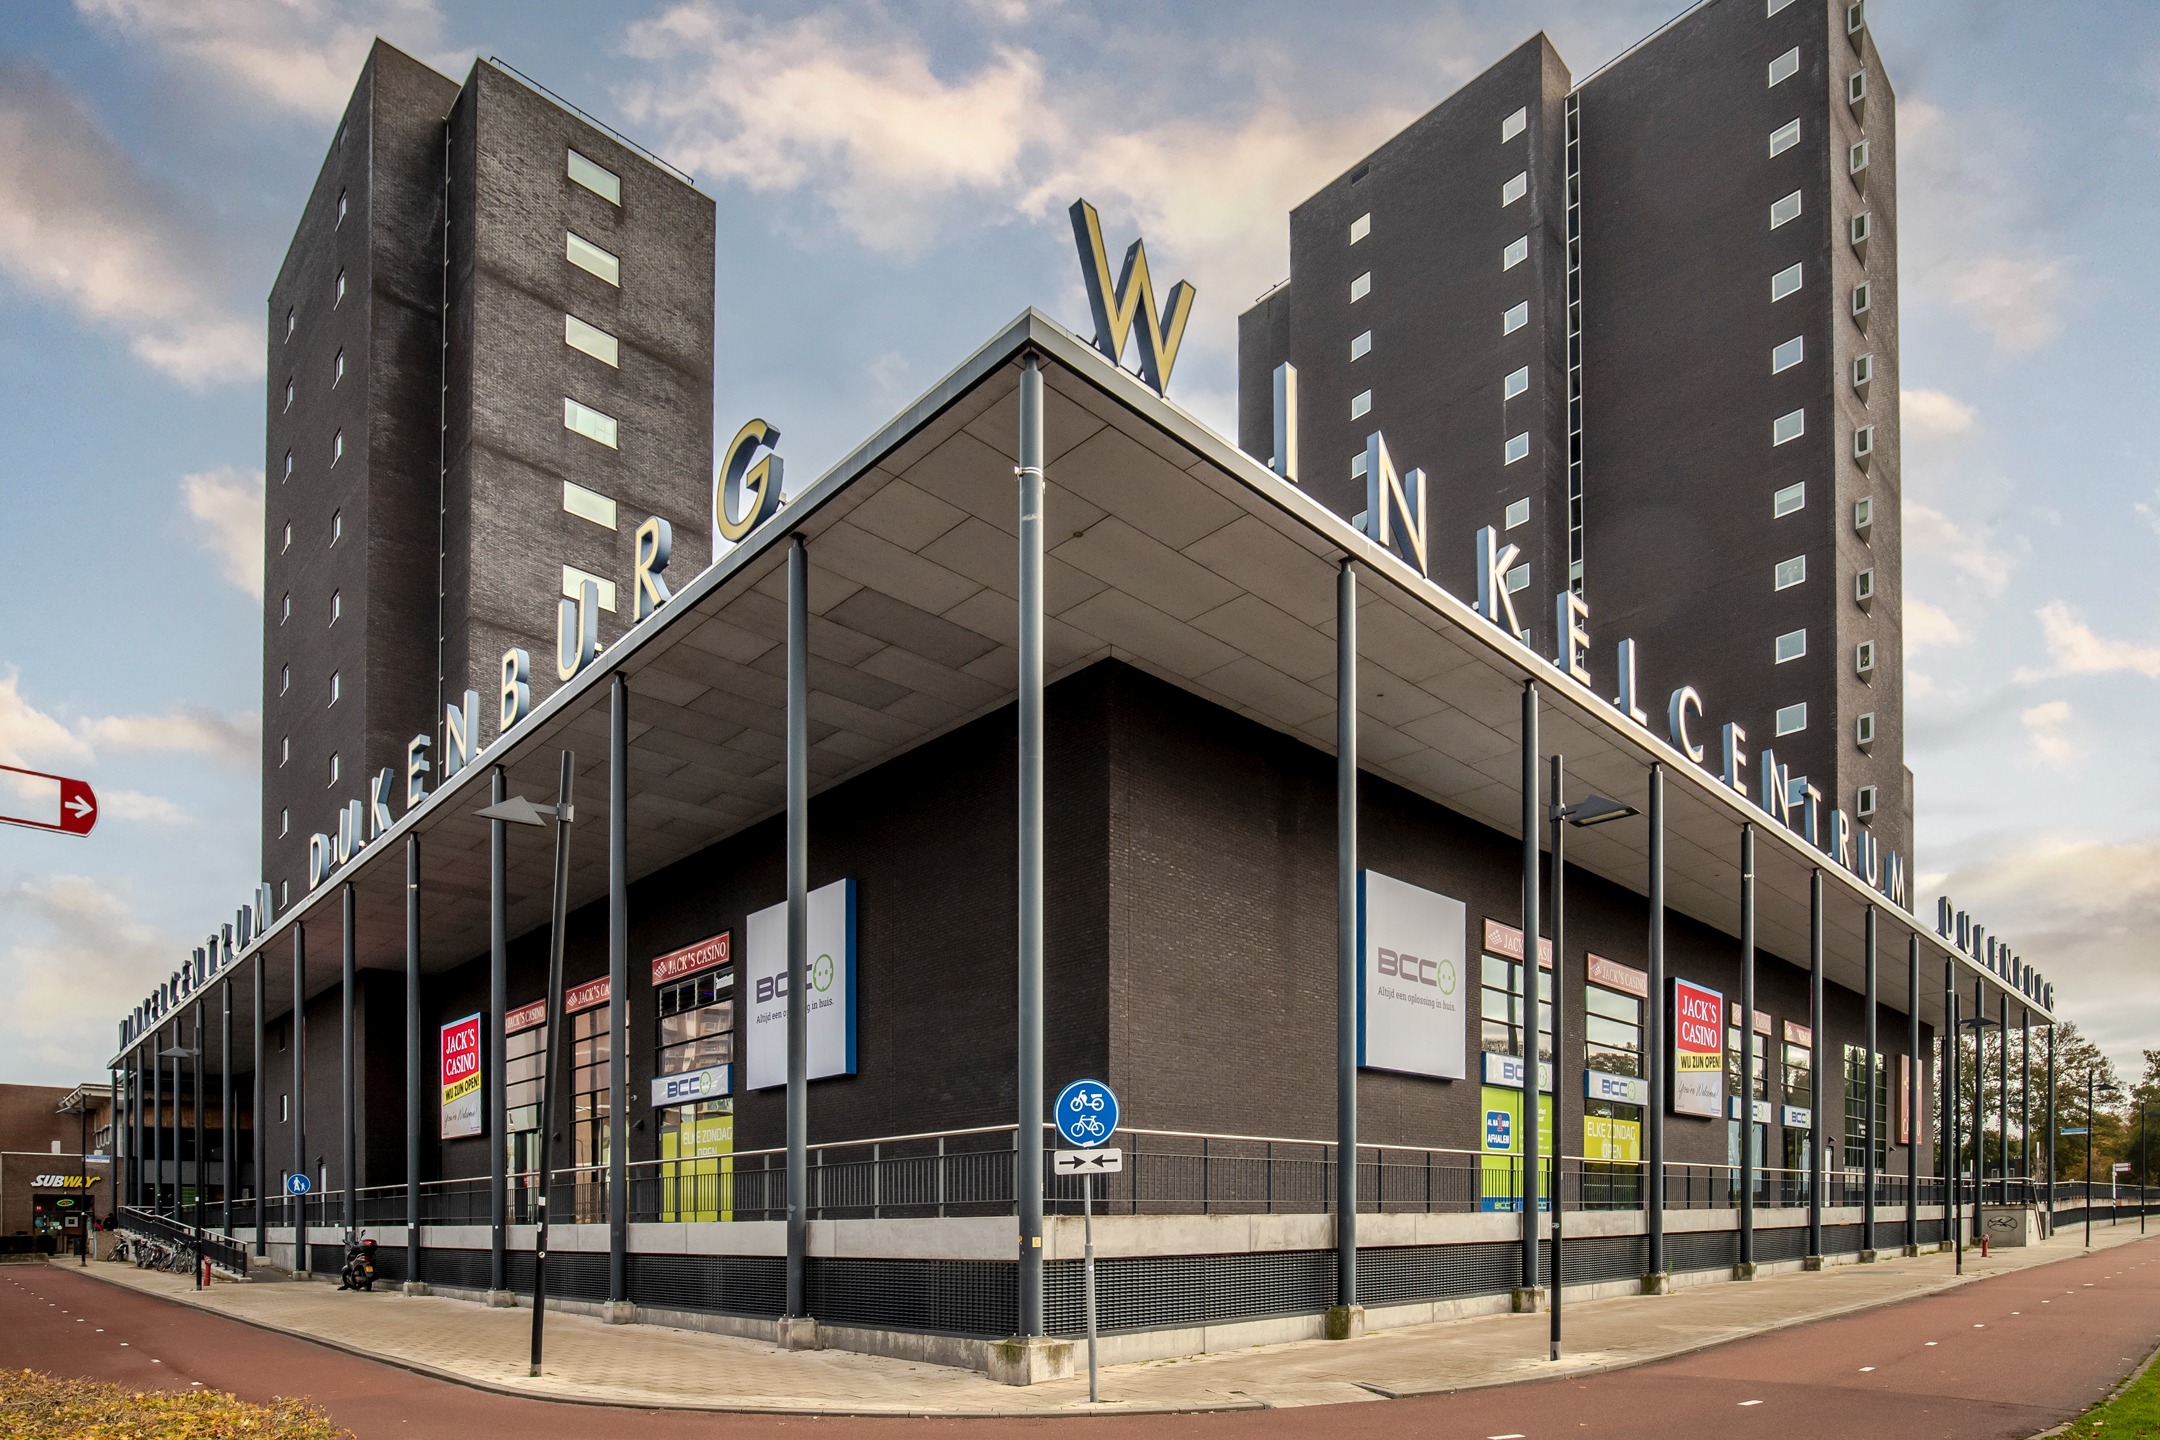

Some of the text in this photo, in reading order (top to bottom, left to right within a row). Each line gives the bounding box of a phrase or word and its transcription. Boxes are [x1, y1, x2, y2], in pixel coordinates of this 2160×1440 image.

[1069, 198, 2056, 1013] WINKELCENTRUM DUKENBURG
[118, 418, 783, 1052] WINKELCENTRUM DUKENBURG
[668, 941, 727, 975] JACK'S CASINO
[1378, 946, 1438, 987] BCC
[1601, 965, 1646, 991] JACK'S CASINO
[578, 985, 601, 1005] JACK'S
[811, 1000, 818, 1010] in
[818, 996, 835, 1009] huis.
[1378, 986, 1457, 1012] Altijd een oplossing in huis.
[524, 1005, 545, 1023] CASINO
[1682, 995, 1717, 1024] JACK'S
[446, 1028, 475, 1055] JACK'S
[1682, 1021, 1717, 1048] CASINO
[446, 1052, 476, 1077] CASINO
[667, 1076, 700, 1099] BCC
[1602, 1078, 1628, 1098] BCC
[683, 1126, 732, 1146] ELKE ZONDAG
[1487, 1133, 1510, 1145] AFHALEN
[1587, 1121, 1636, 1141] ELKE ZONDAG
[1602, 1143, 1622, 1159] OPEN
[30, 1174, 101, 1188] SUBWAY
